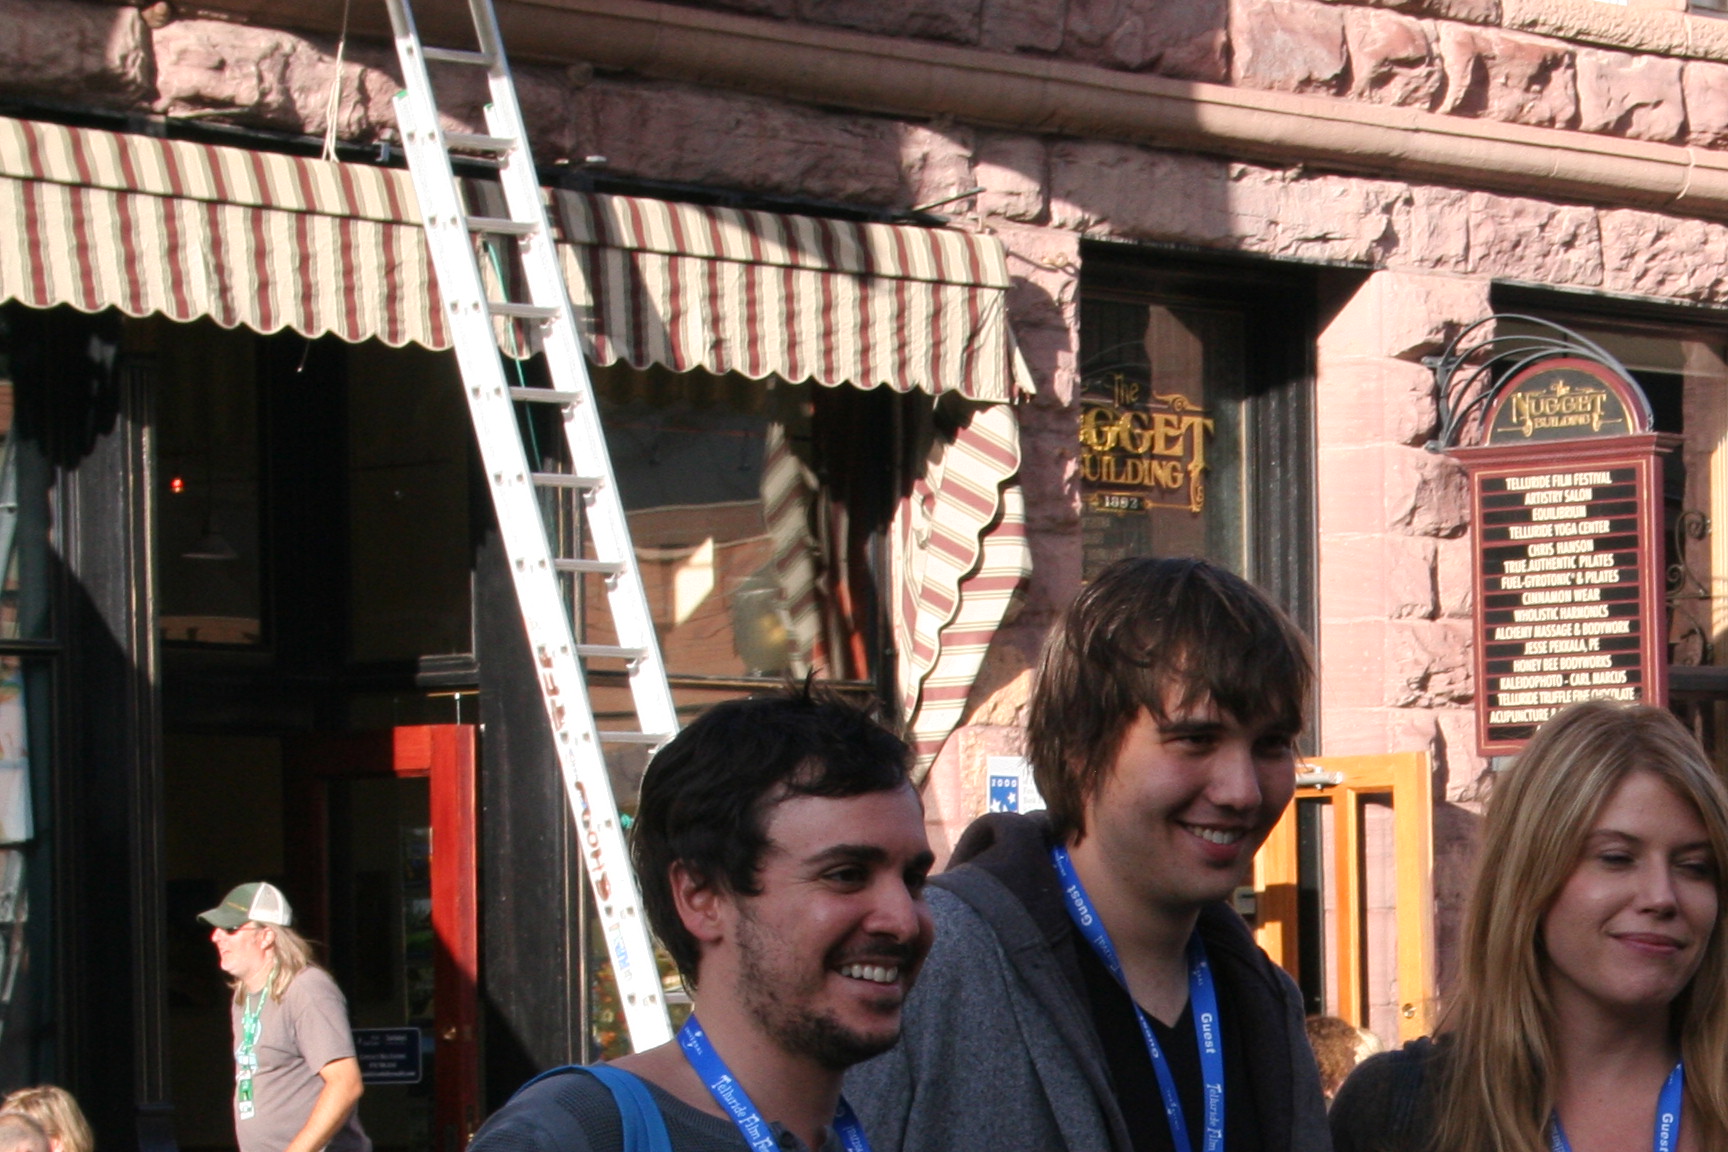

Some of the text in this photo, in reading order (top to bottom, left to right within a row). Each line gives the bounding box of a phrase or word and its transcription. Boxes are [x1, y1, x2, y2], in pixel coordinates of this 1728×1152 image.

[1512, 391, 1607, 423] NUGGET
[1533, 413, 1591, 429] BUILDING
[1079, 407, 1214, 471] GGET
[1079, 453, 1184, 489] UILDING
[1505, 471, 1612, 491] TELLURIDE FILM FESTIVAL
[1524, 487, 1592, 505] ARTISTRY SALON
[1532, 505, 1587, 521] EQUILIBRIUM
[1509, 520, 1610, 540] TELLURIDE YOGA CENTER
[1527, 539, 1594, 557] CHRIS HANSON
[1578, 553, 1614, 568] PILATES
[1576, 571, 1584, 585] &
[1585, 569, 1619, 583] PILATES
[1522, 588, 1601, 605] CINNAMON WEAR
[1513, 604, 1609, 622] WHOLISTIC HARMONICS
[1495, 620, 1630, 640] ALCHEMY MASSAGE & BODYWORK
[1524, 637, 1600, 655] JESSE PEKKALA, PE
[1513, 654, 1612, 672] HONEY BEE BODYWORKS
[1499, 674, 1563, 690] KALEIDOPHOTO
[1569, 673, 1591, 686] CARL
[1592, 670, 1627, 685] MARCUS
[1497, 692, 1539, 706] TELLURIDE
[1539, 690, 1571, 704] TRUFFLE
[1572, 688, 1591, 702] FINE
[1489, 708, 1549, 723] ACUPUNCTURE
[1067, 884, 1093, 926] Guest
[1200, 1012, 1216, 1054] Guest
[711, 1074, 746, 1118] Telluride
[738, 1113, 760, 1141] Film
[1206, 1083, 1222, 1127] Telluride
[1206, 1128, 1222, 1151] Film
